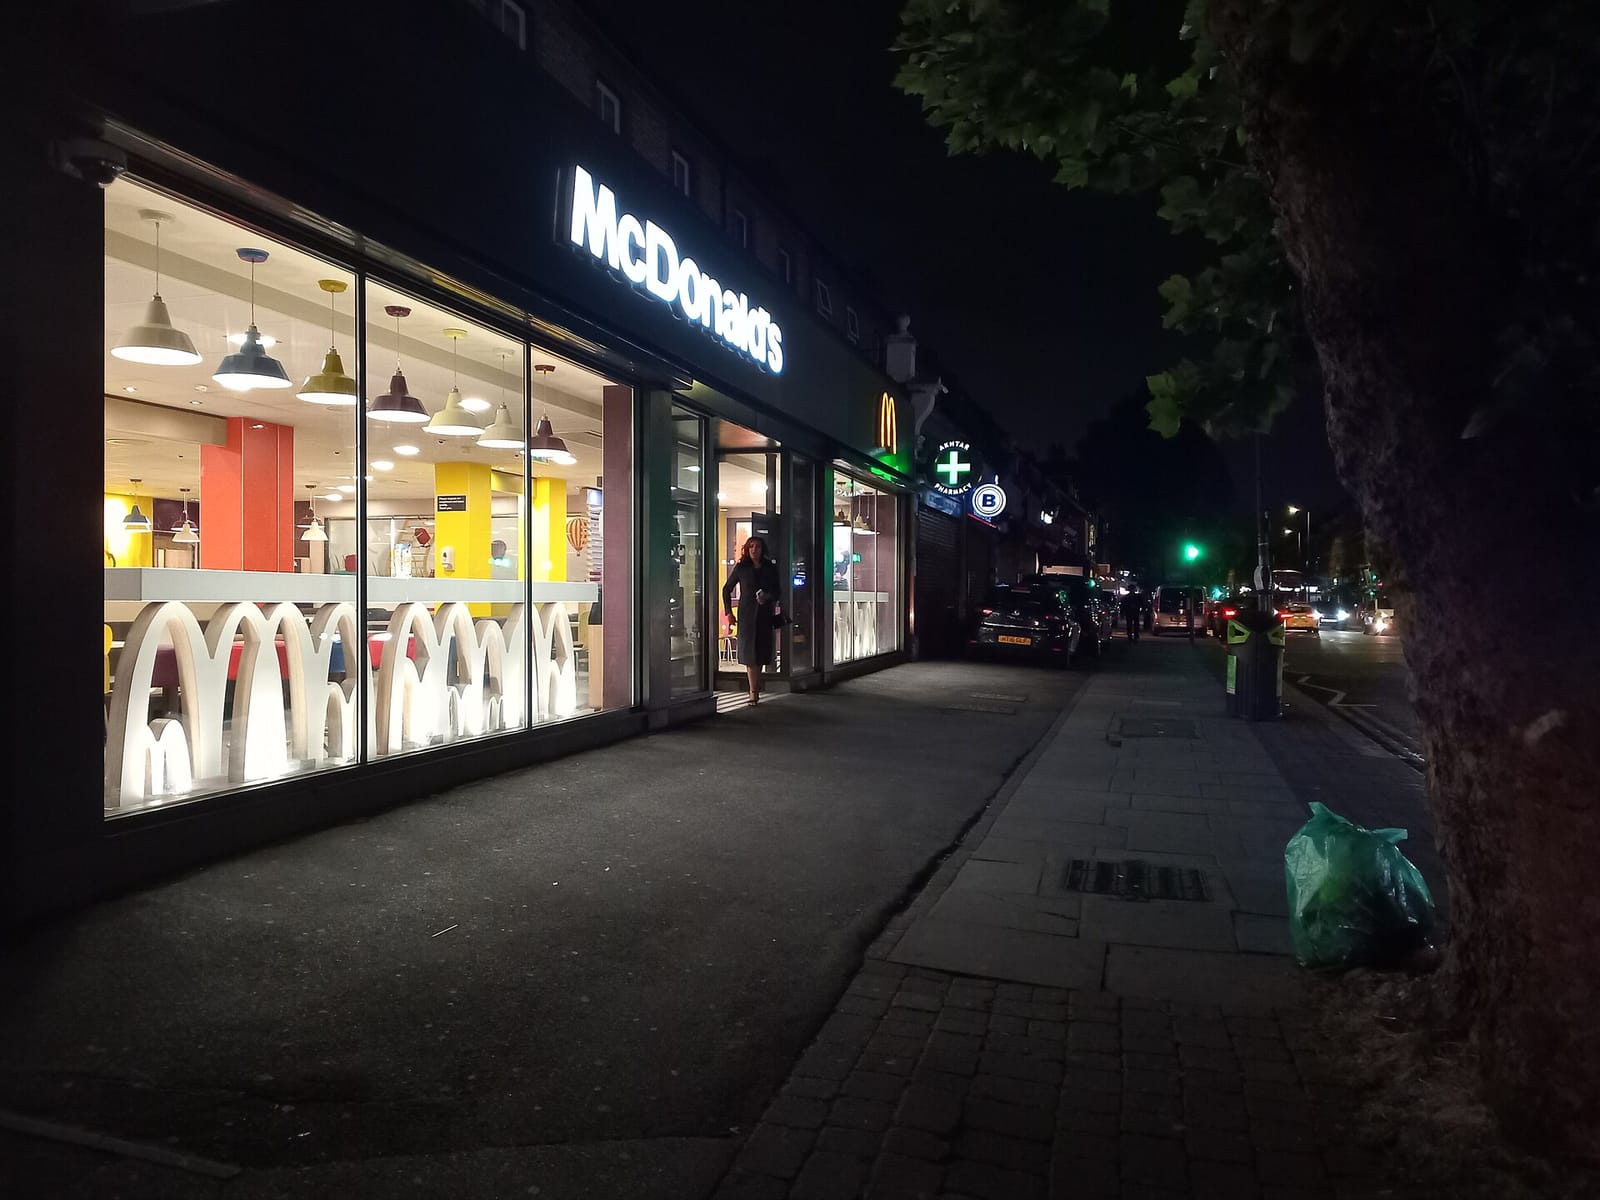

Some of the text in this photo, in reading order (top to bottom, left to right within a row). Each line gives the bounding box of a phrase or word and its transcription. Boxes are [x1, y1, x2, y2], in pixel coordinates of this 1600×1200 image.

[570, 164, 784, 375] McDonald's
[939, 440, 970, 451] AKHTAR
[934, 482, 972, 495] PHARMACY
[982, 494, 996, 507] B
